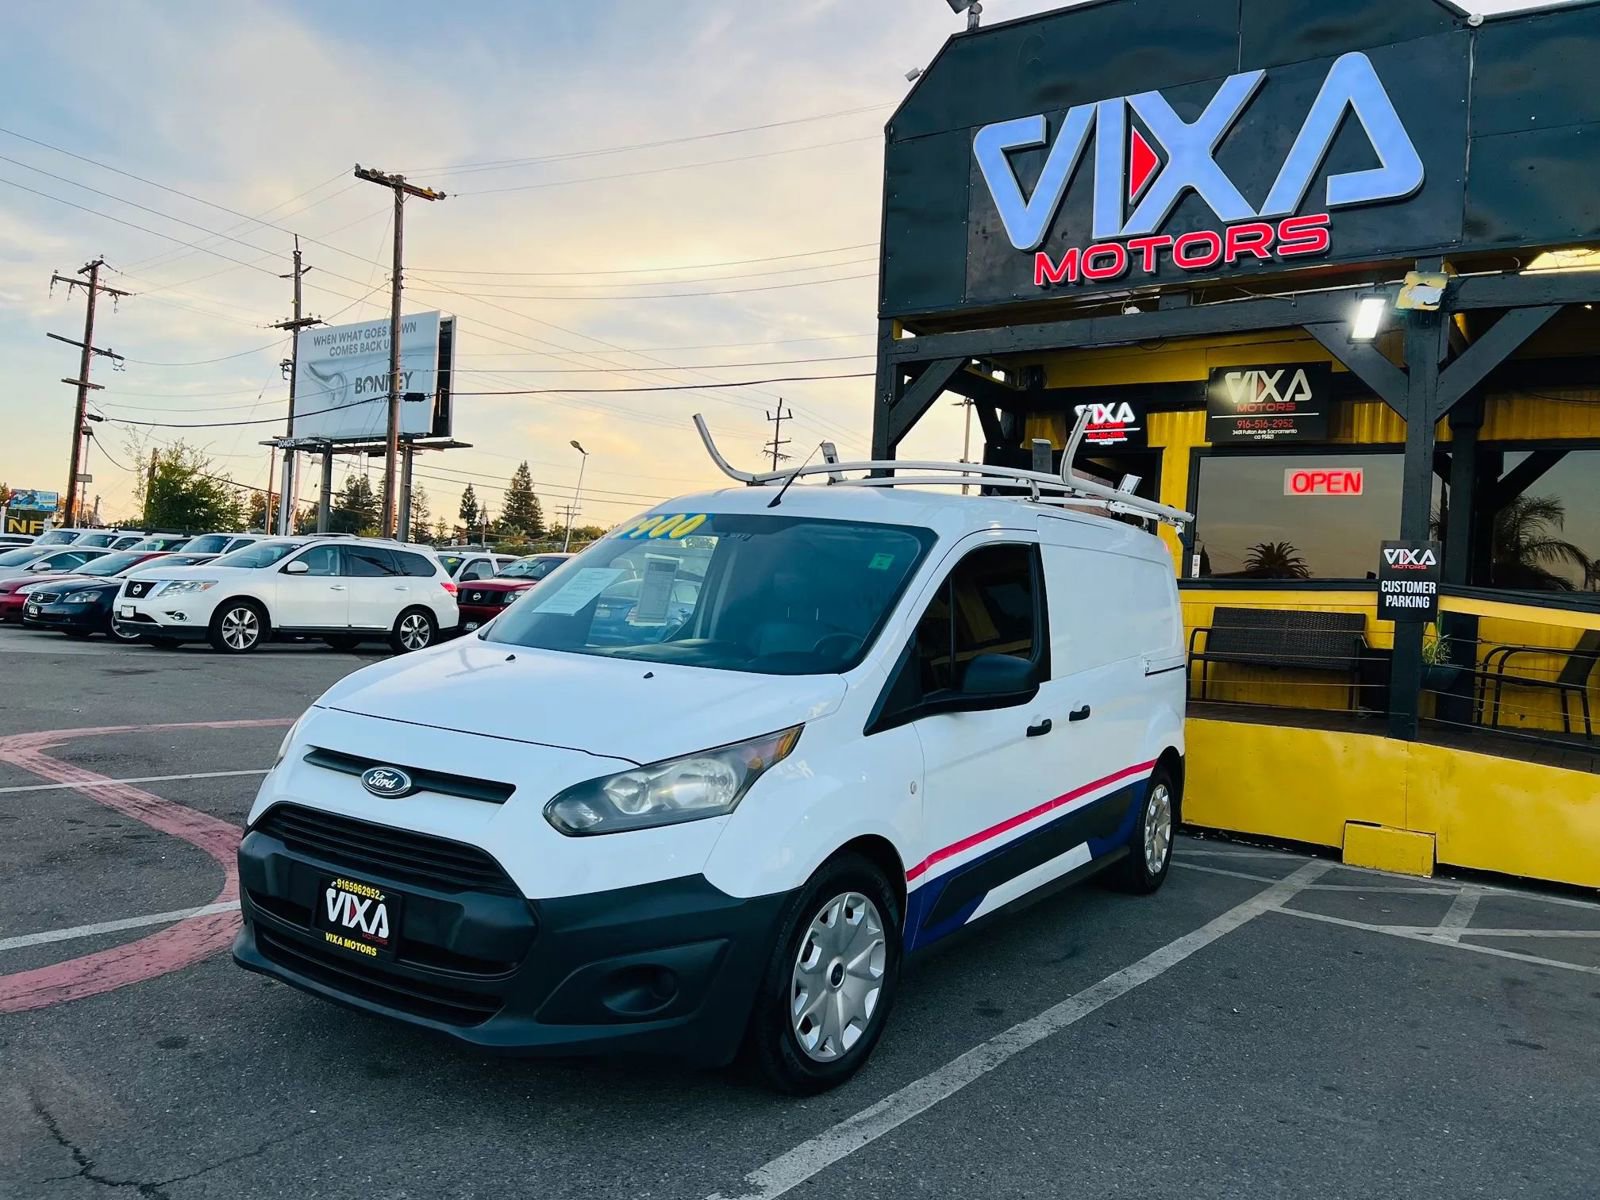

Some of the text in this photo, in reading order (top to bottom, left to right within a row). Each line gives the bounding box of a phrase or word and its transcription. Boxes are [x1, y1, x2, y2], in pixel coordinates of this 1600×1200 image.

[973, 52, 1425, 251] VIXA
[1033, 213, 1331, 286] MOTORS
[313, 321, 417, 346] WHEN WHAT GOES WN
[329, 343, 358, 357] COMES
[359, 340, 382, 353] BACK
[1225, 368, 1313, 403] VIXA
[1237, 402, 1297, 412] MOTORS
[1236, 419, 1294, 429] 916-516-2952
[1292, 471, 1361, 494] OPEN
[1383, 548, 1437, 566] VIXA
[1381, 580, 1437, 594] CUSTOMER
[1385, 594, 1430, 609] PARKING
[368, 770, 399, 789] Ford
[336, 878, 381, 901] 9165962952
[326, 887, 390, 939] VIXA
[325, 931, 378, 957] VIXA MOTORS
